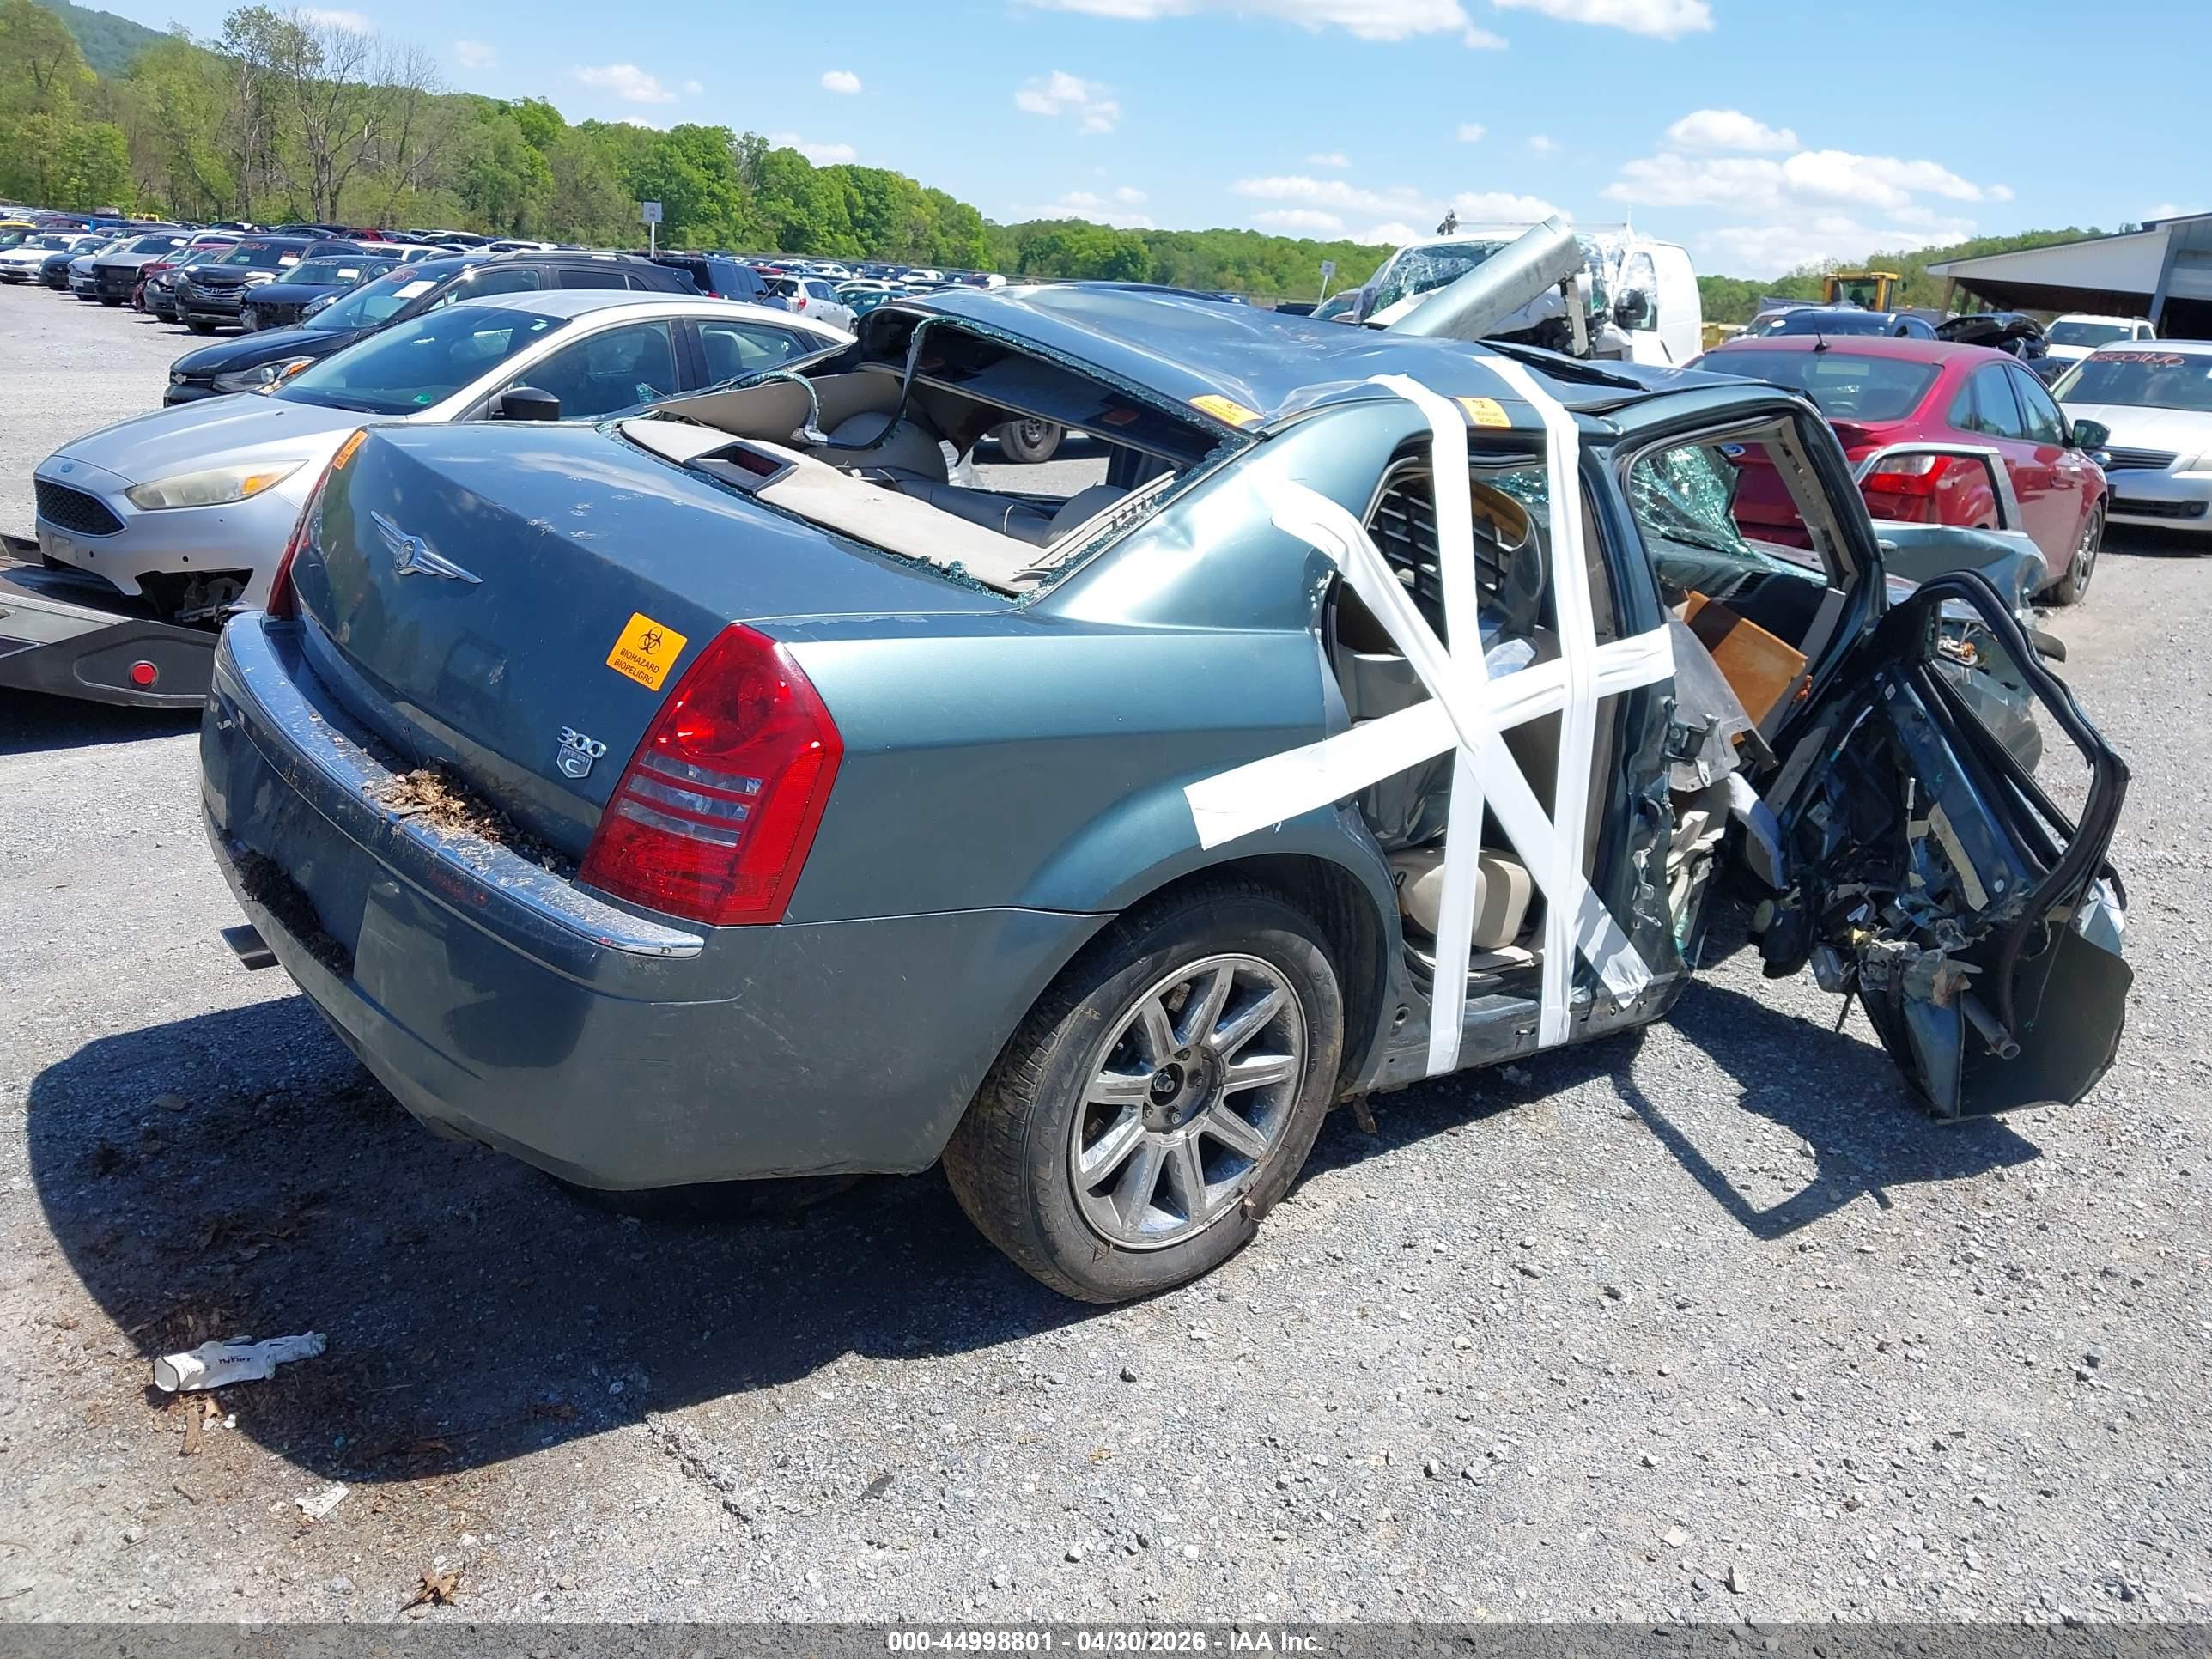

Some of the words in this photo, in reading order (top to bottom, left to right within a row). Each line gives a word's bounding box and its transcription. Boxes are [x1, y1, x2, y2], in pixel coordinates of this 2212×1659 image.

[614, 659, 654, 684] BIOPELIGRO
[620, 648, 659, 674] BIOHAZARD
[557, 726, 607, 758] 300
[565, 758, 581, 774] C
